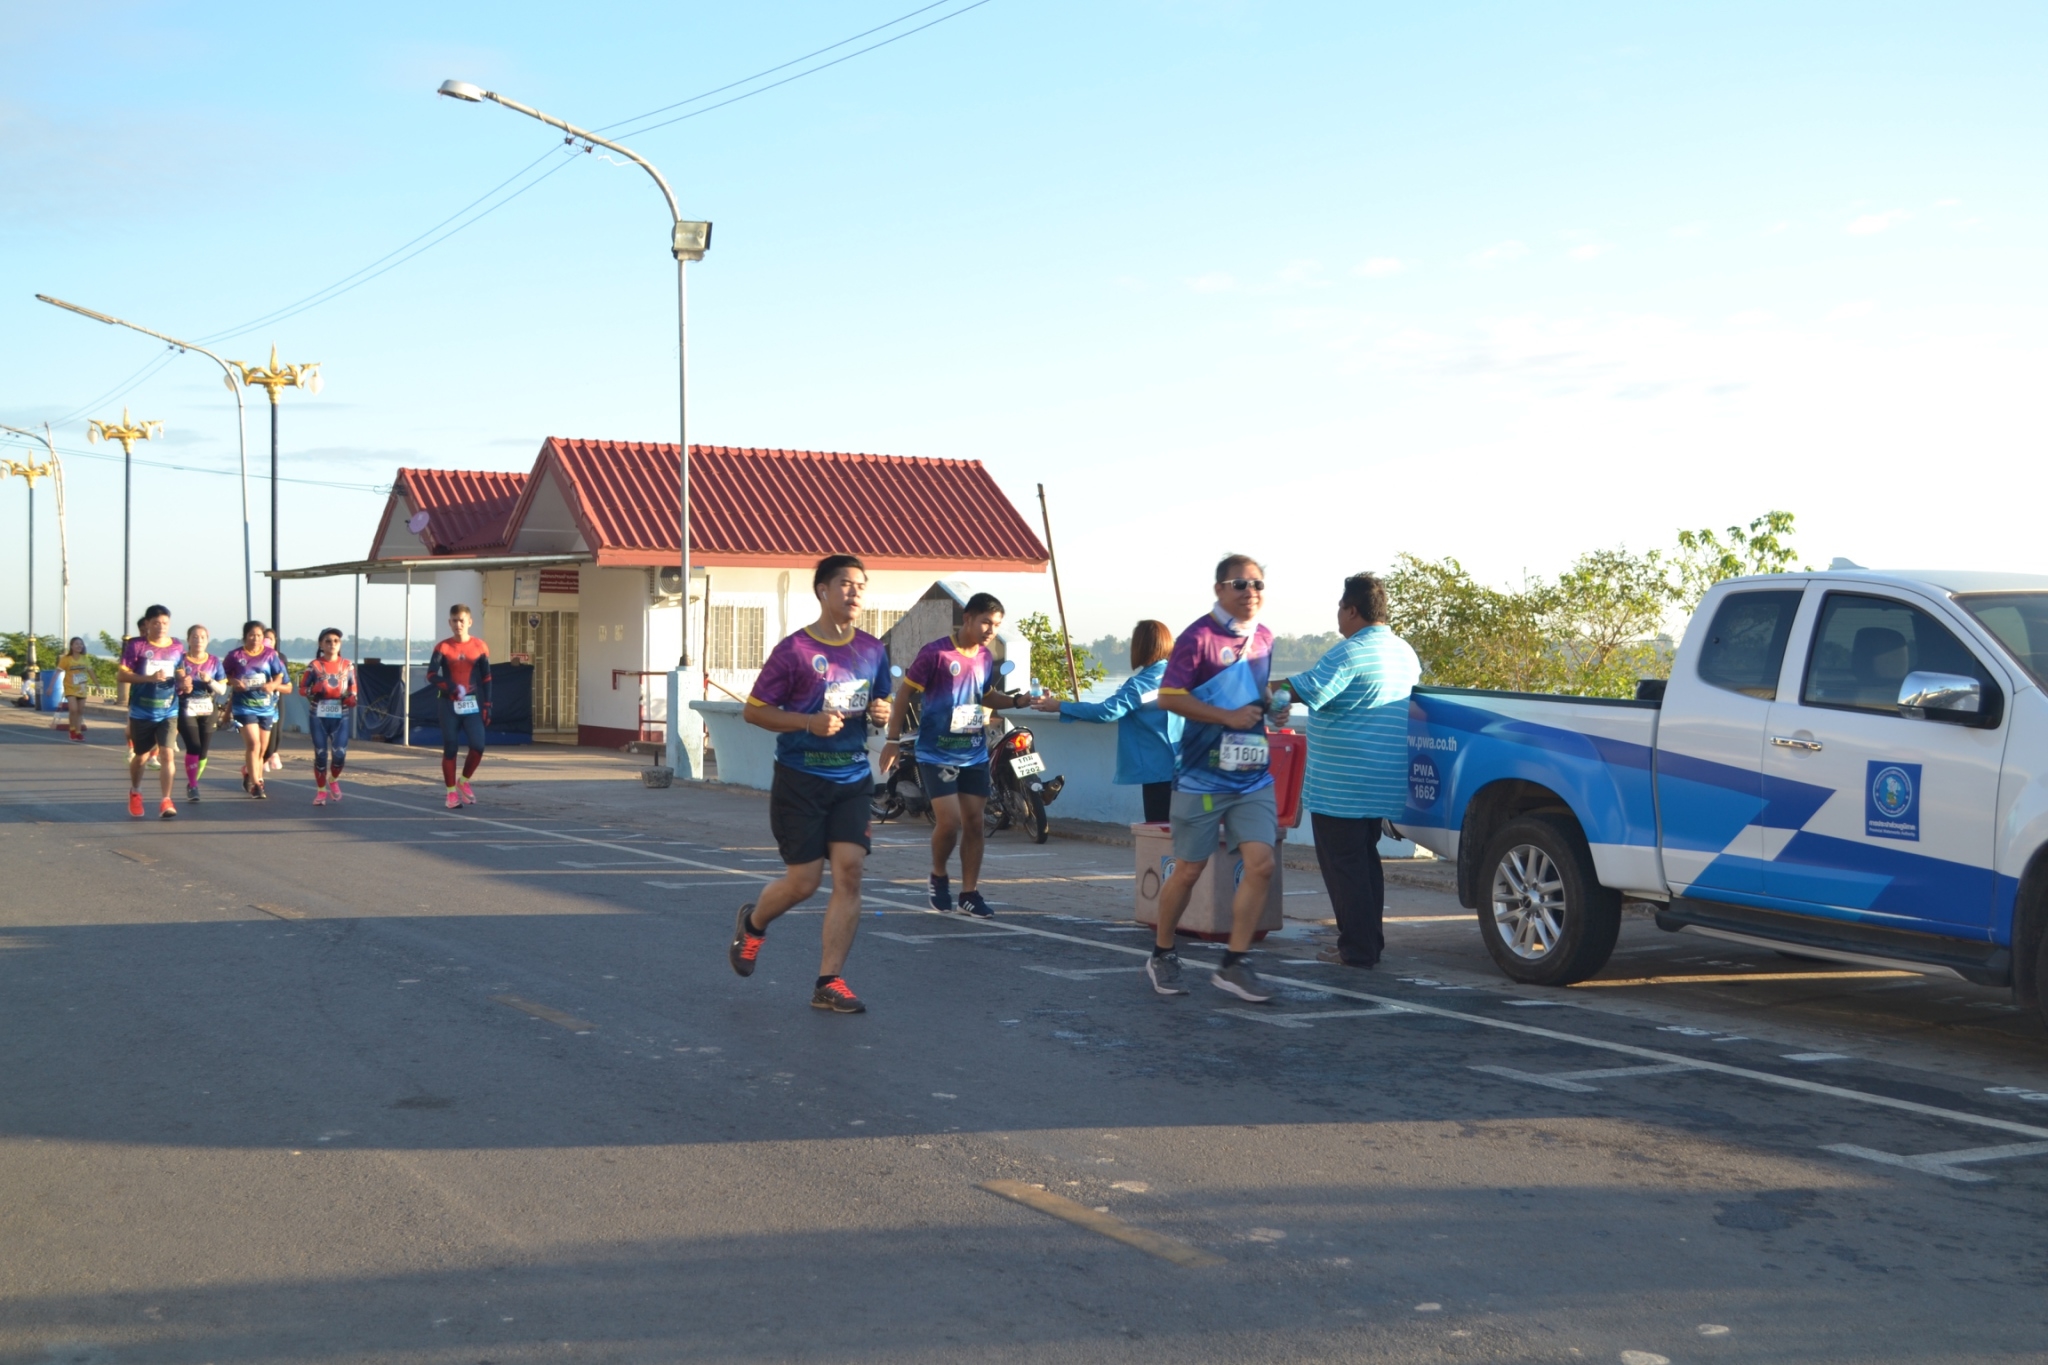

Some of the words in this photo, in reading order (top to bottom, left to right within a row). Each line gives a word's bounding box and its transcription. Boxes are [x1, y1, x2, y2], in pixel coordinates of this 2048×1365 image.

[1234, 747, 1265, 763] 1601
[1020, 765, 1040, 776] 7202
[1413, 763, 1435, 777] PWA
[1426, 777, 1439, 785] Center
[1414, 784, 1436, 800] 1662
